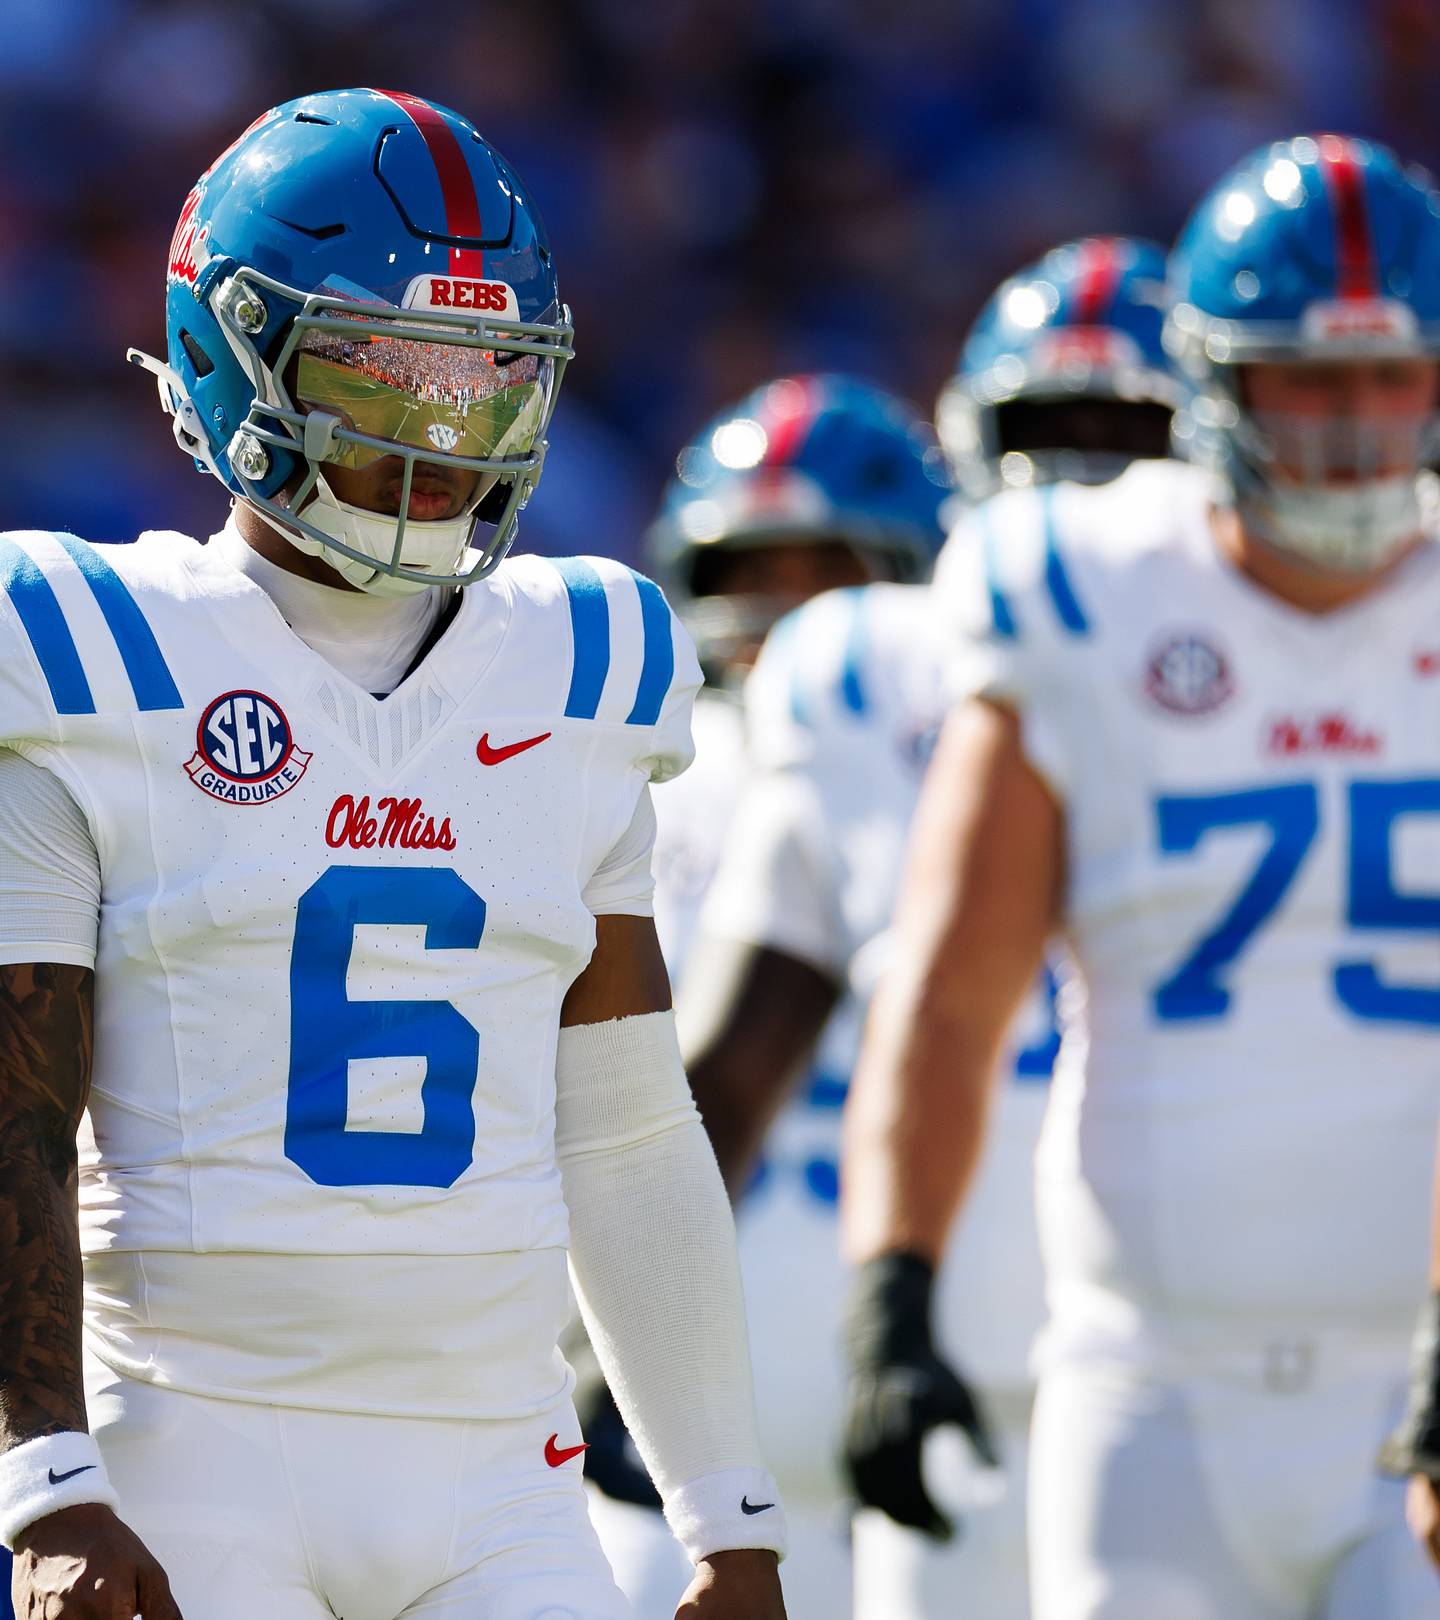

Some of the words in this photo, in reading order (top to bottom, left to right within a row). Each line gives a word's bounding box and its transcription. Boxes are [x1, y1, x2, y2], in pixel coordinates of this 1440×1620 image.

[430, 279, 508, 312] REBS
[207, 696, 284, 775] SEC
[200, 766, 298, 803] GRADUATE
[325, 794, 377, 850] Ole
[378, 795, 457, 851] Miss
[1148, 777, 1440, 1032] 75
[283, 864, 487, 1188] 6
